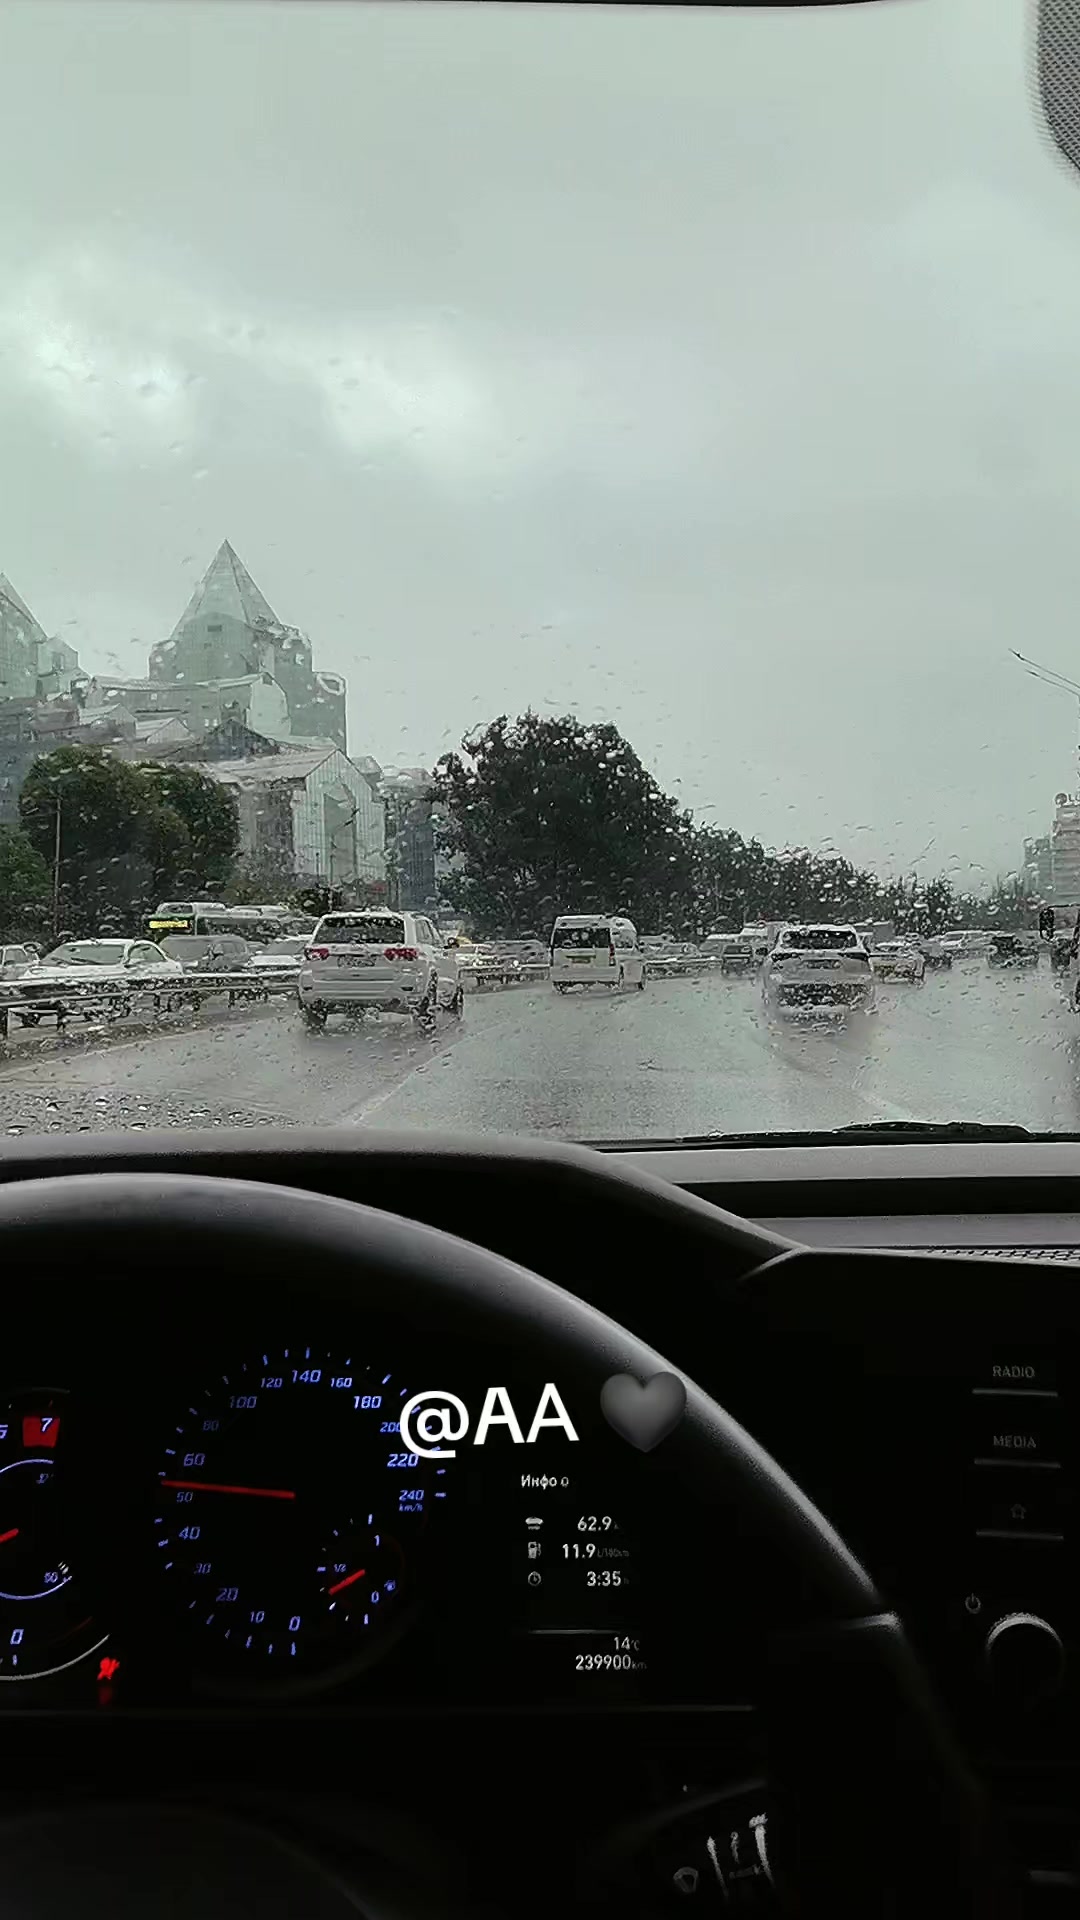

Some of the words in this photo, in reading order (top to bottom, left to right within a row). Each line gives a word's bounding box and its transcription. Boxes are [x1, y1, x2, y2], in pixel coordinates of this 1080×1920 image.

[292, 1369, 322, 1383] 140
[992, 1365, 1036, 1378] RADIO
[260, 1377, 283, 1389] 120
[330, 1377, 353, 1389] 160
[230, 1395, 258, 1409] 100
[353, 1395, 383, 1410] 180
[41, 1417, 54, 1433] 7
[202, 1418, 220, 1432] 80
[993, 1435, 1037, 1449] MEDIA
[183, 1453, 206, 1467] 60
[386, 1453, 420, 1468] 220
[521, 1474, 557, 1490] Инфо
[176, 1491, 194, 1503] 50
[398, 1489, 425, 1502] 240
[398, 1503, 423, 1512] km/h
[577, 1515, 612, 1532] 62.9
[178, 1526, 201, 1540] 40
[373, 1534, 381, 1547] 1
[562, 1543, 596, 1559] 11.9
[194, 1562, 212, 1575] 30
[586, 1570, 622, 1587] 3:35
[215, 1587, 239, 1602] 20
[371, 1590, 380, 1604] 0
[250, 1610, 265, 1624] 10
[288, 1615, 301, 1632] 0
[9, 1628, 24, 1645] 0
